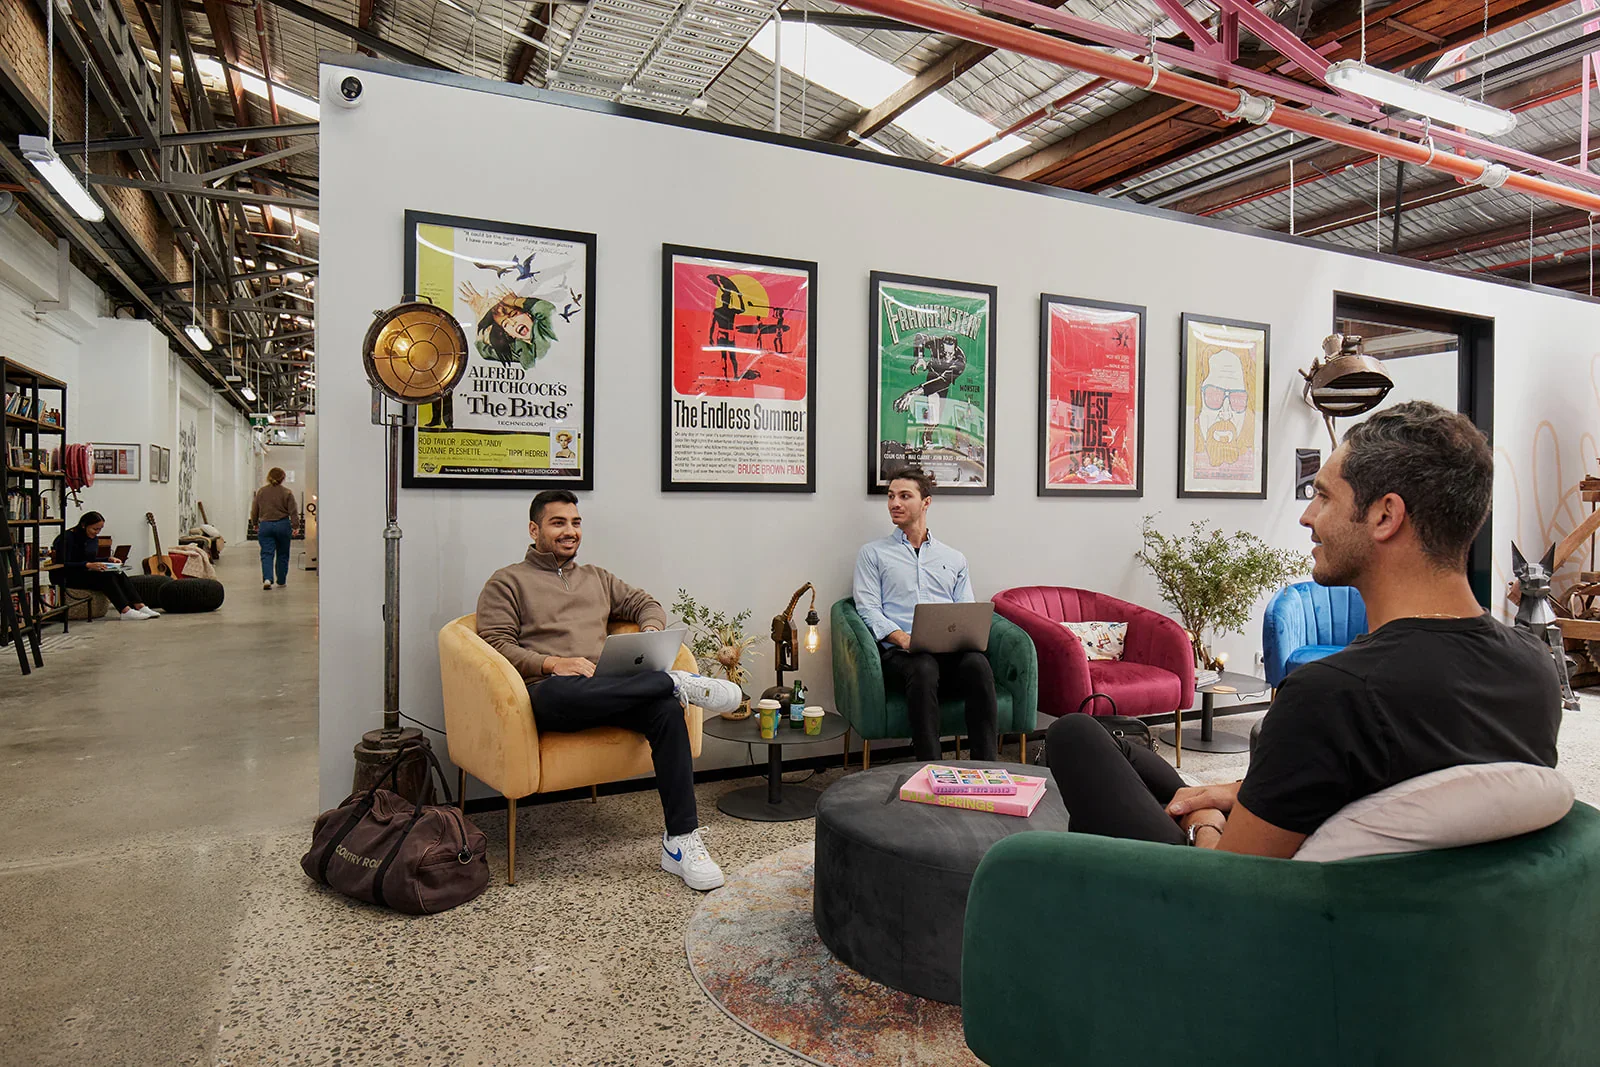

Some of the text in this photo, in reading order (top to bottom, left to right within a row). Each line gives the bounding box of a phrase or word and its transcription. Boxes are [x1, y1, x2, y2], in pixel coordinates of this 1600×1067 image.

[468, 366, 525, 381] ALFRED
[473, 379, 567, 396] HITCHCOCK'S
[1070, 389, 1112, 419] WEST
[674, 400, 805, 432] The Endless Summer
[418, 437, 431, 446] ROD
[434, 437, 456, 446] TAYLOR
[738, 463, 805, 475] BRUCE BROWN FILMS
[902, 789, 995, 811] PALM SPRINGS
